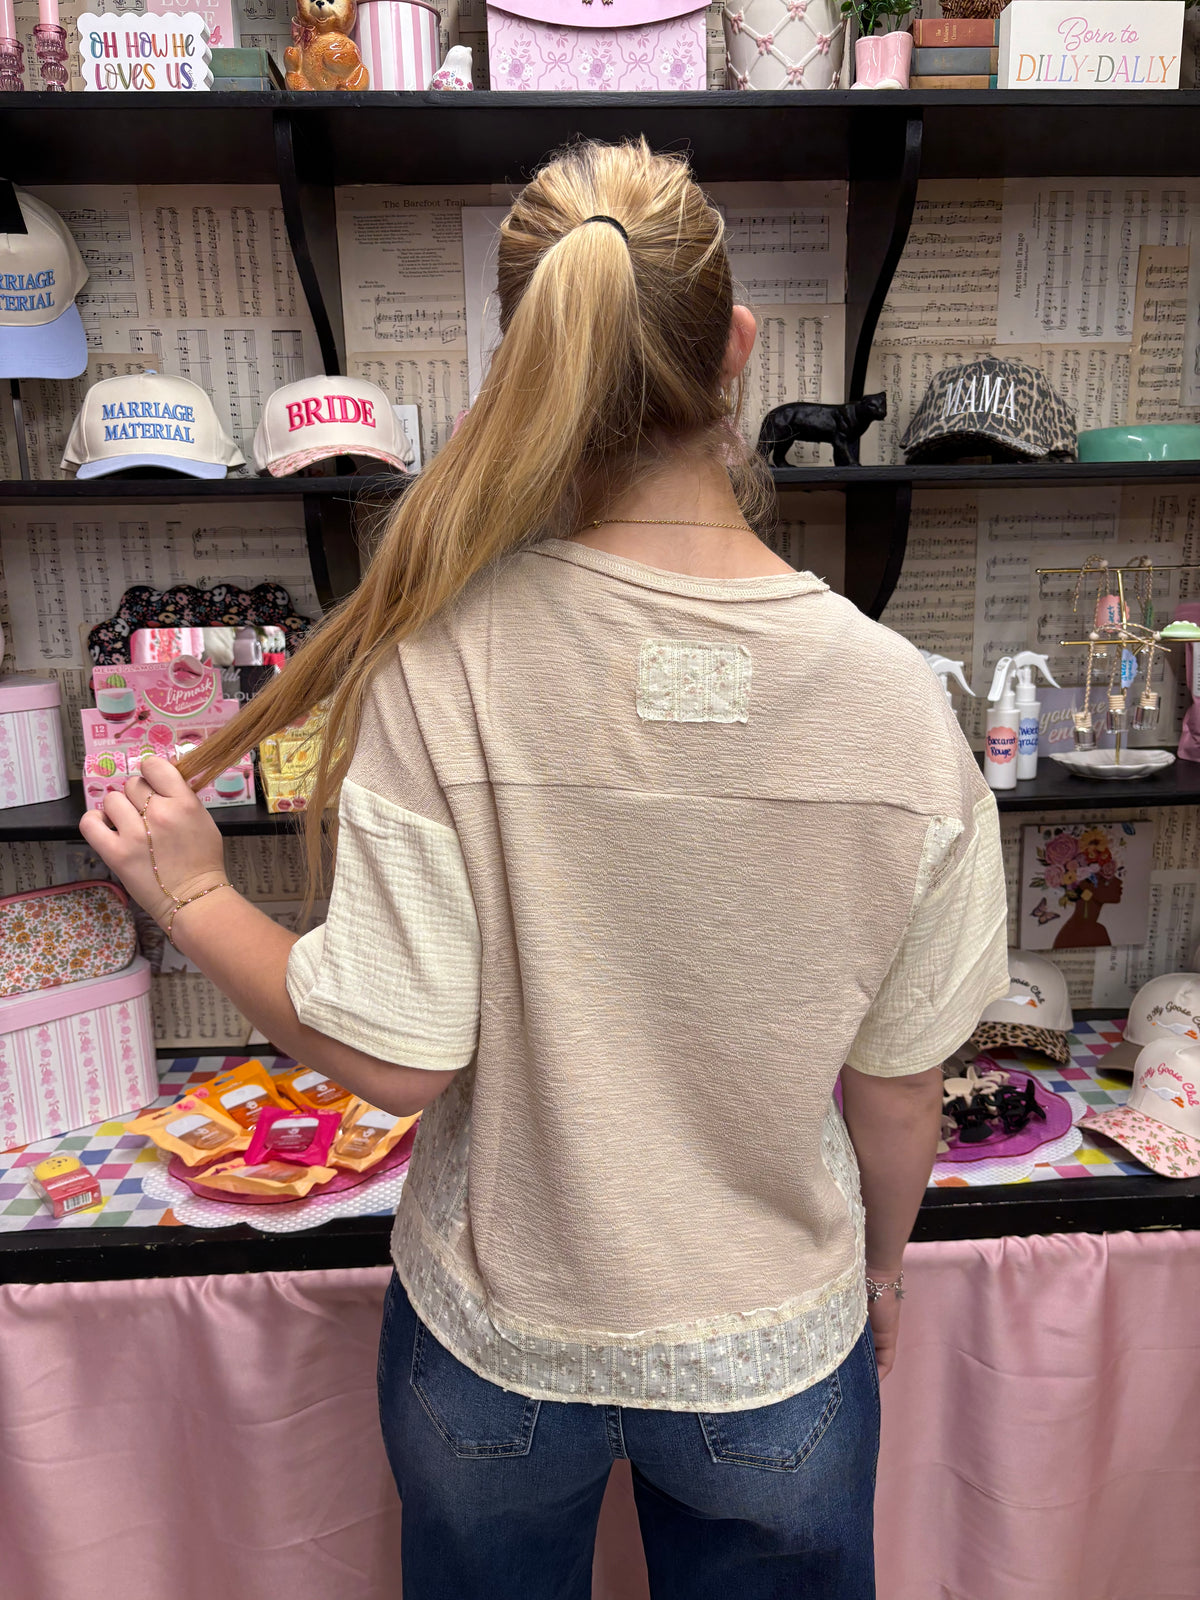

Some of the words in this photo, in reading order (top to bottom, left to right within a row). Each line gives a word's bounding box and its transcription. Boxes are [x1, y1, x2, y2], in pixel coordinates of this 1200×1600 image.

[89, 31, 119, 59] OH
[125, 31, 168, 58] HOW
[1057, 16, 1116, 51] Born
[1120, 24, 1139, 43] to
[1016, 54, 1177, 84] DILLY-DALLY
[382, 200, 400, 209] The
[403, 199, 441, 208] Barefoot
[1015, 232, 1025, 257] Tango
[1013, 259, 1024, 299] Argentine
[101, 401, 195, 423] MARRIAGE
[939, 375, 1017, 421] MAMA
[286, 395, 376, 432] BRIDE
[103, 421, 195, 444] MATERIAL
[1010, 977, 1030, 987] oose
[1165, 1001, 1192, 1016] Goose
[1157, 1062, 1183, 1082] Goose
[1182, 1082, 1199, 1106] Club
